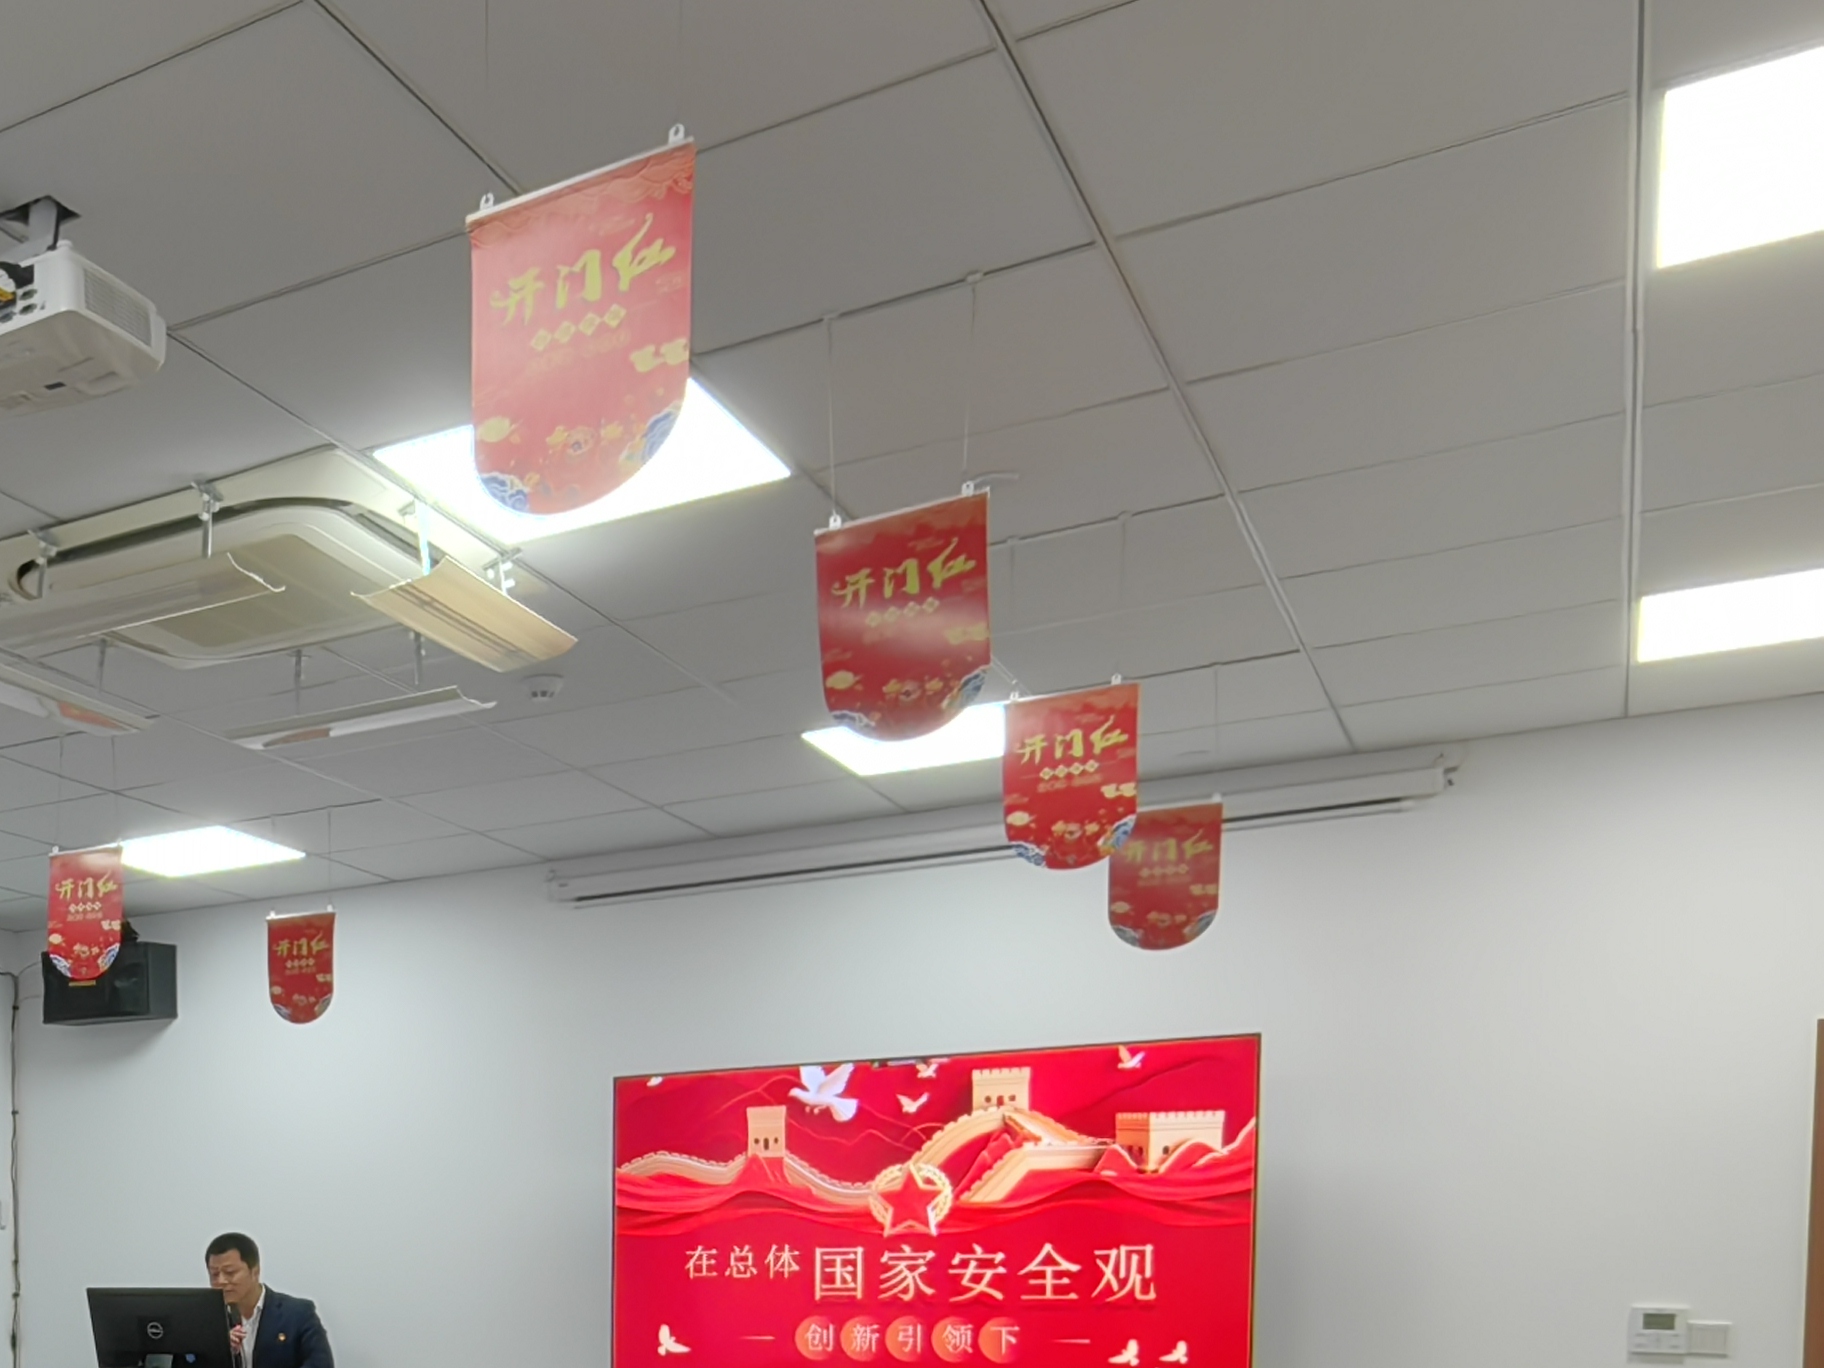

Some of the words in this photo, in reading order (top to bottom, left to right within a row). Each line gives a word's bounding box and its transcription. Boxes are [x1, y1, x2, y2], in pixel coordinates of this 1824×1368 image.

[490, 213, 676, 327] 开门红
[833, 538, 976, 609] 开门红
[1014, 715, 1128, 764] 开门红
[55, 871, 117, 899] 开门红
[686, 1244, 800, 1280] 在总体
[814, 1242, 1157, 1302] 国家安全观
[805, 1320, 1020, 1356] 创新引领下
